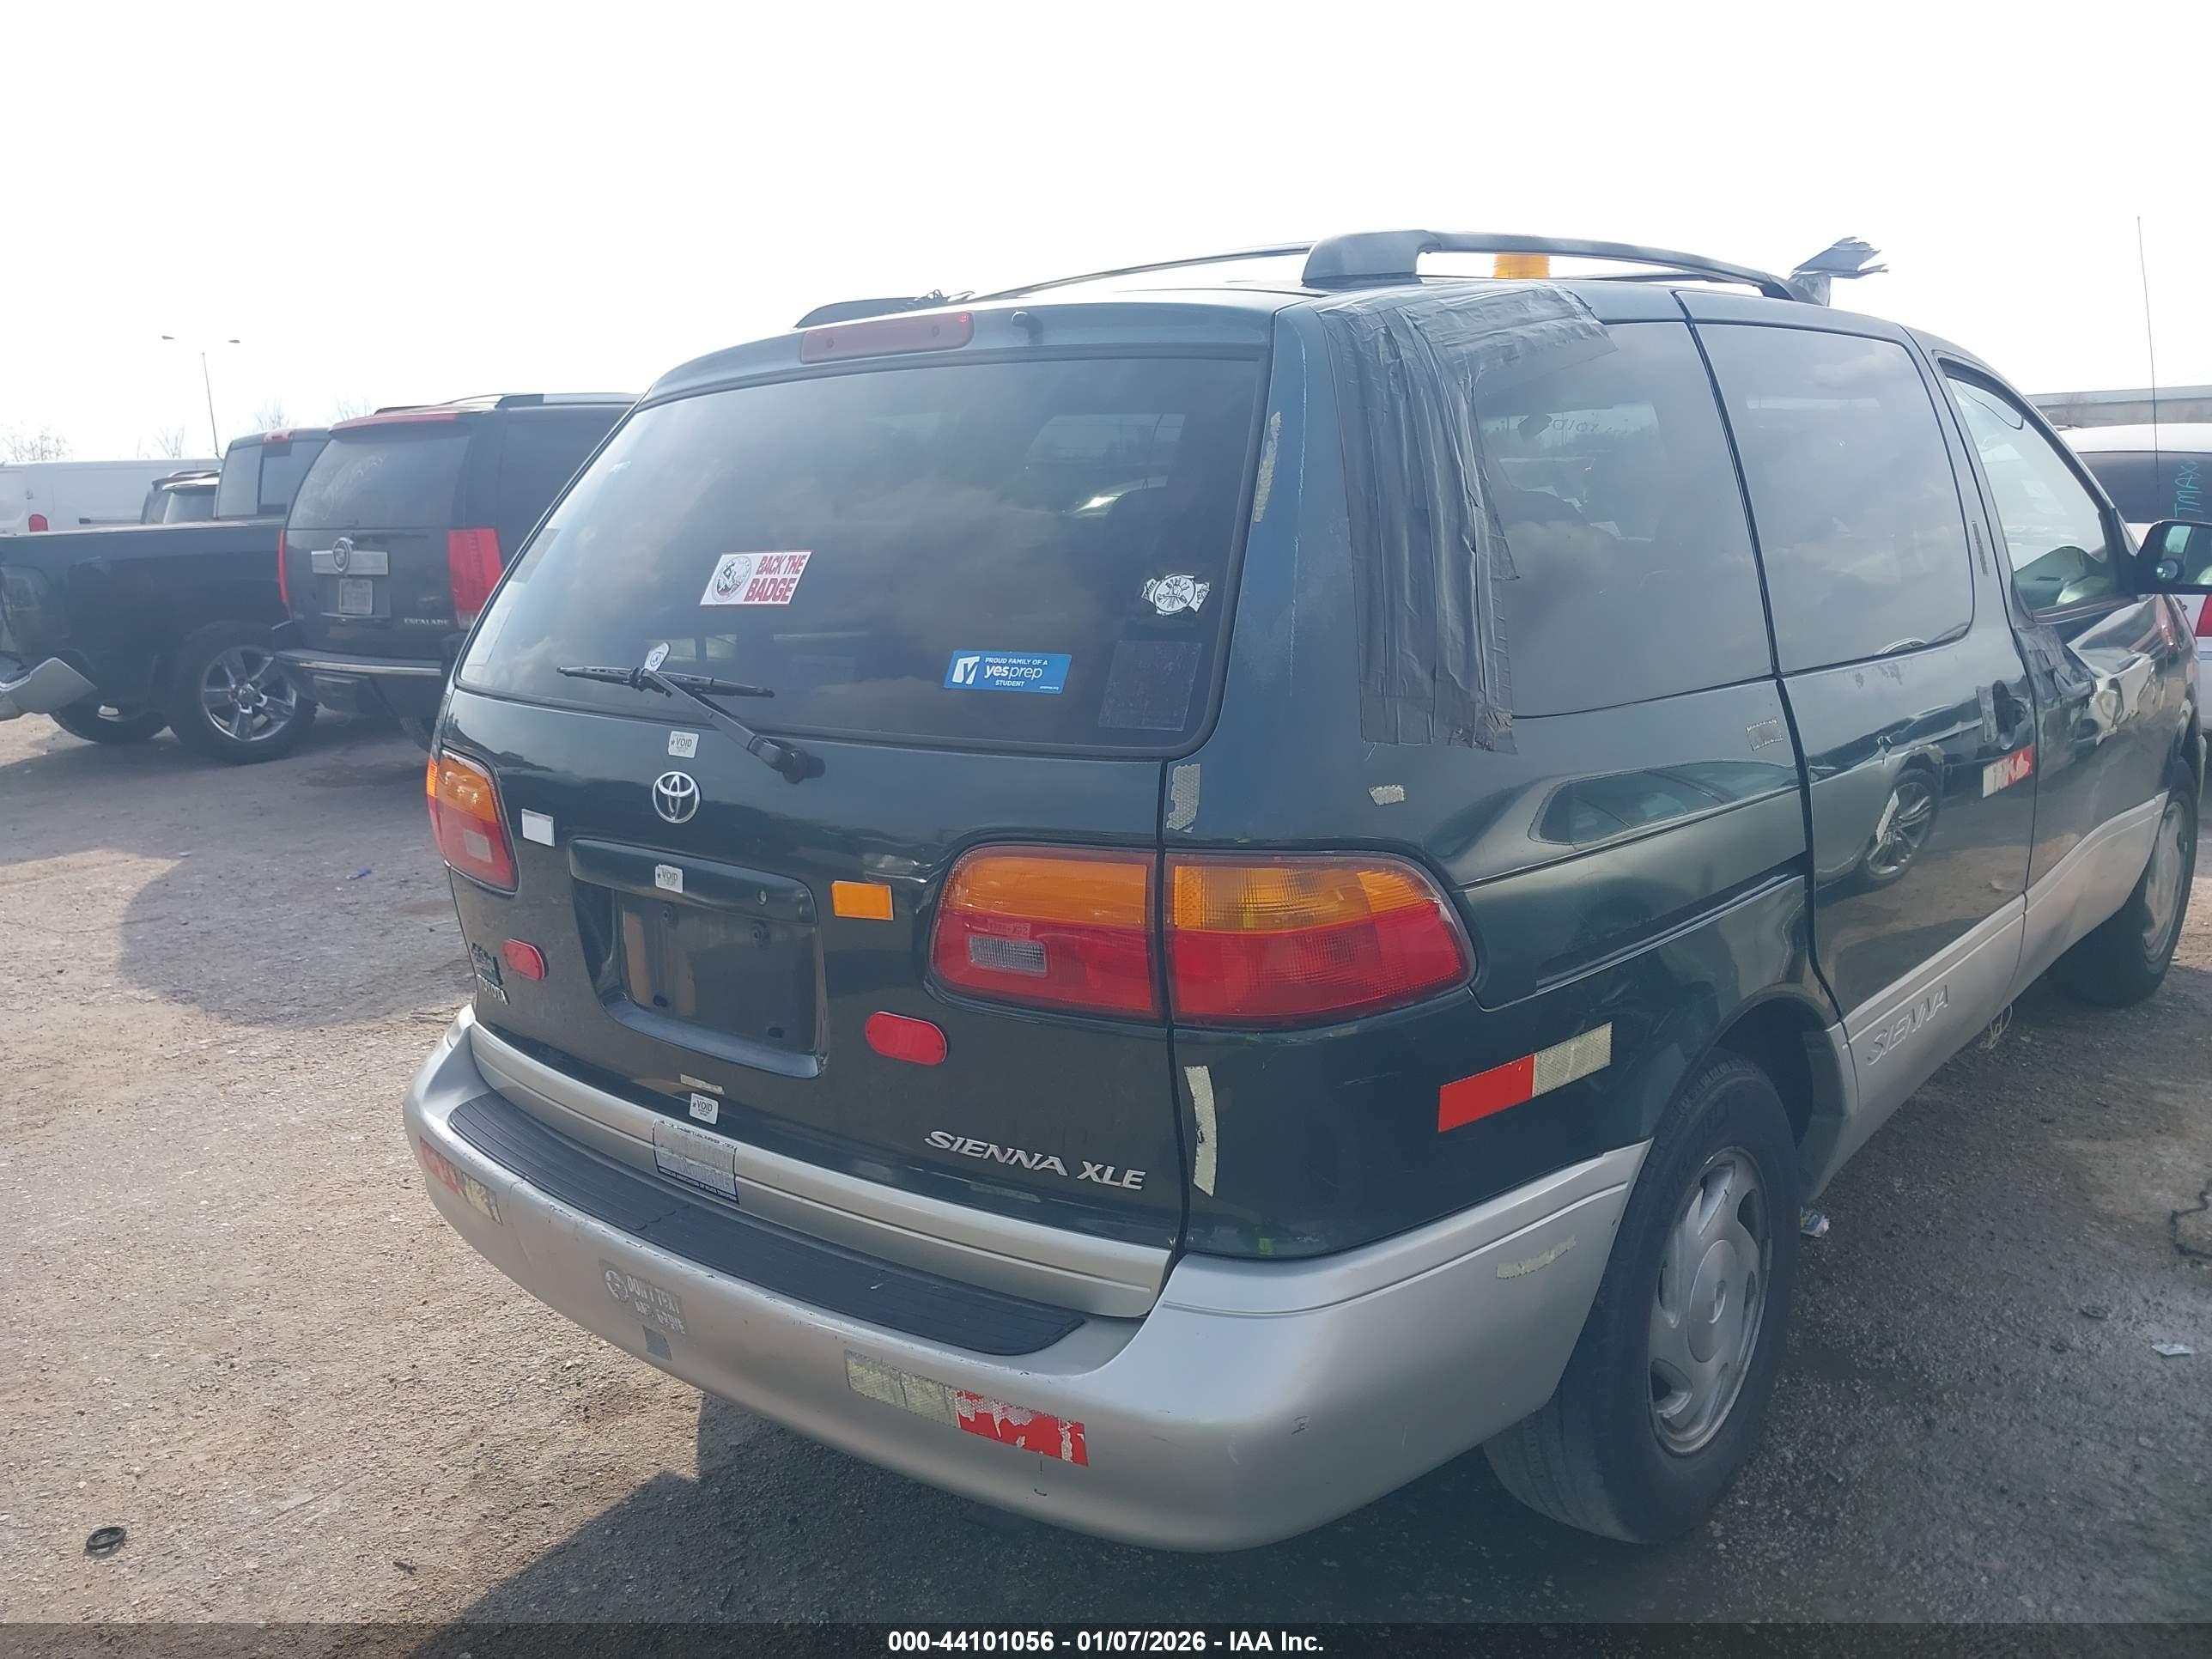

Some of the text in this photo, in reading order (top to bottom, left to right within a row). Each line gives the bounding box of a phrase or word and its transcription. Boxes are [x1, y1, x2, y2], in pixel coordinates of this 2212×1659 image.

[756, 555, 807, 575] BACK THE
[744, 578, 797, 602] BADGE
[984, 665, 1043, 680] yesprep
[924, 1130, 1146, 1190] SIENNA XLE
